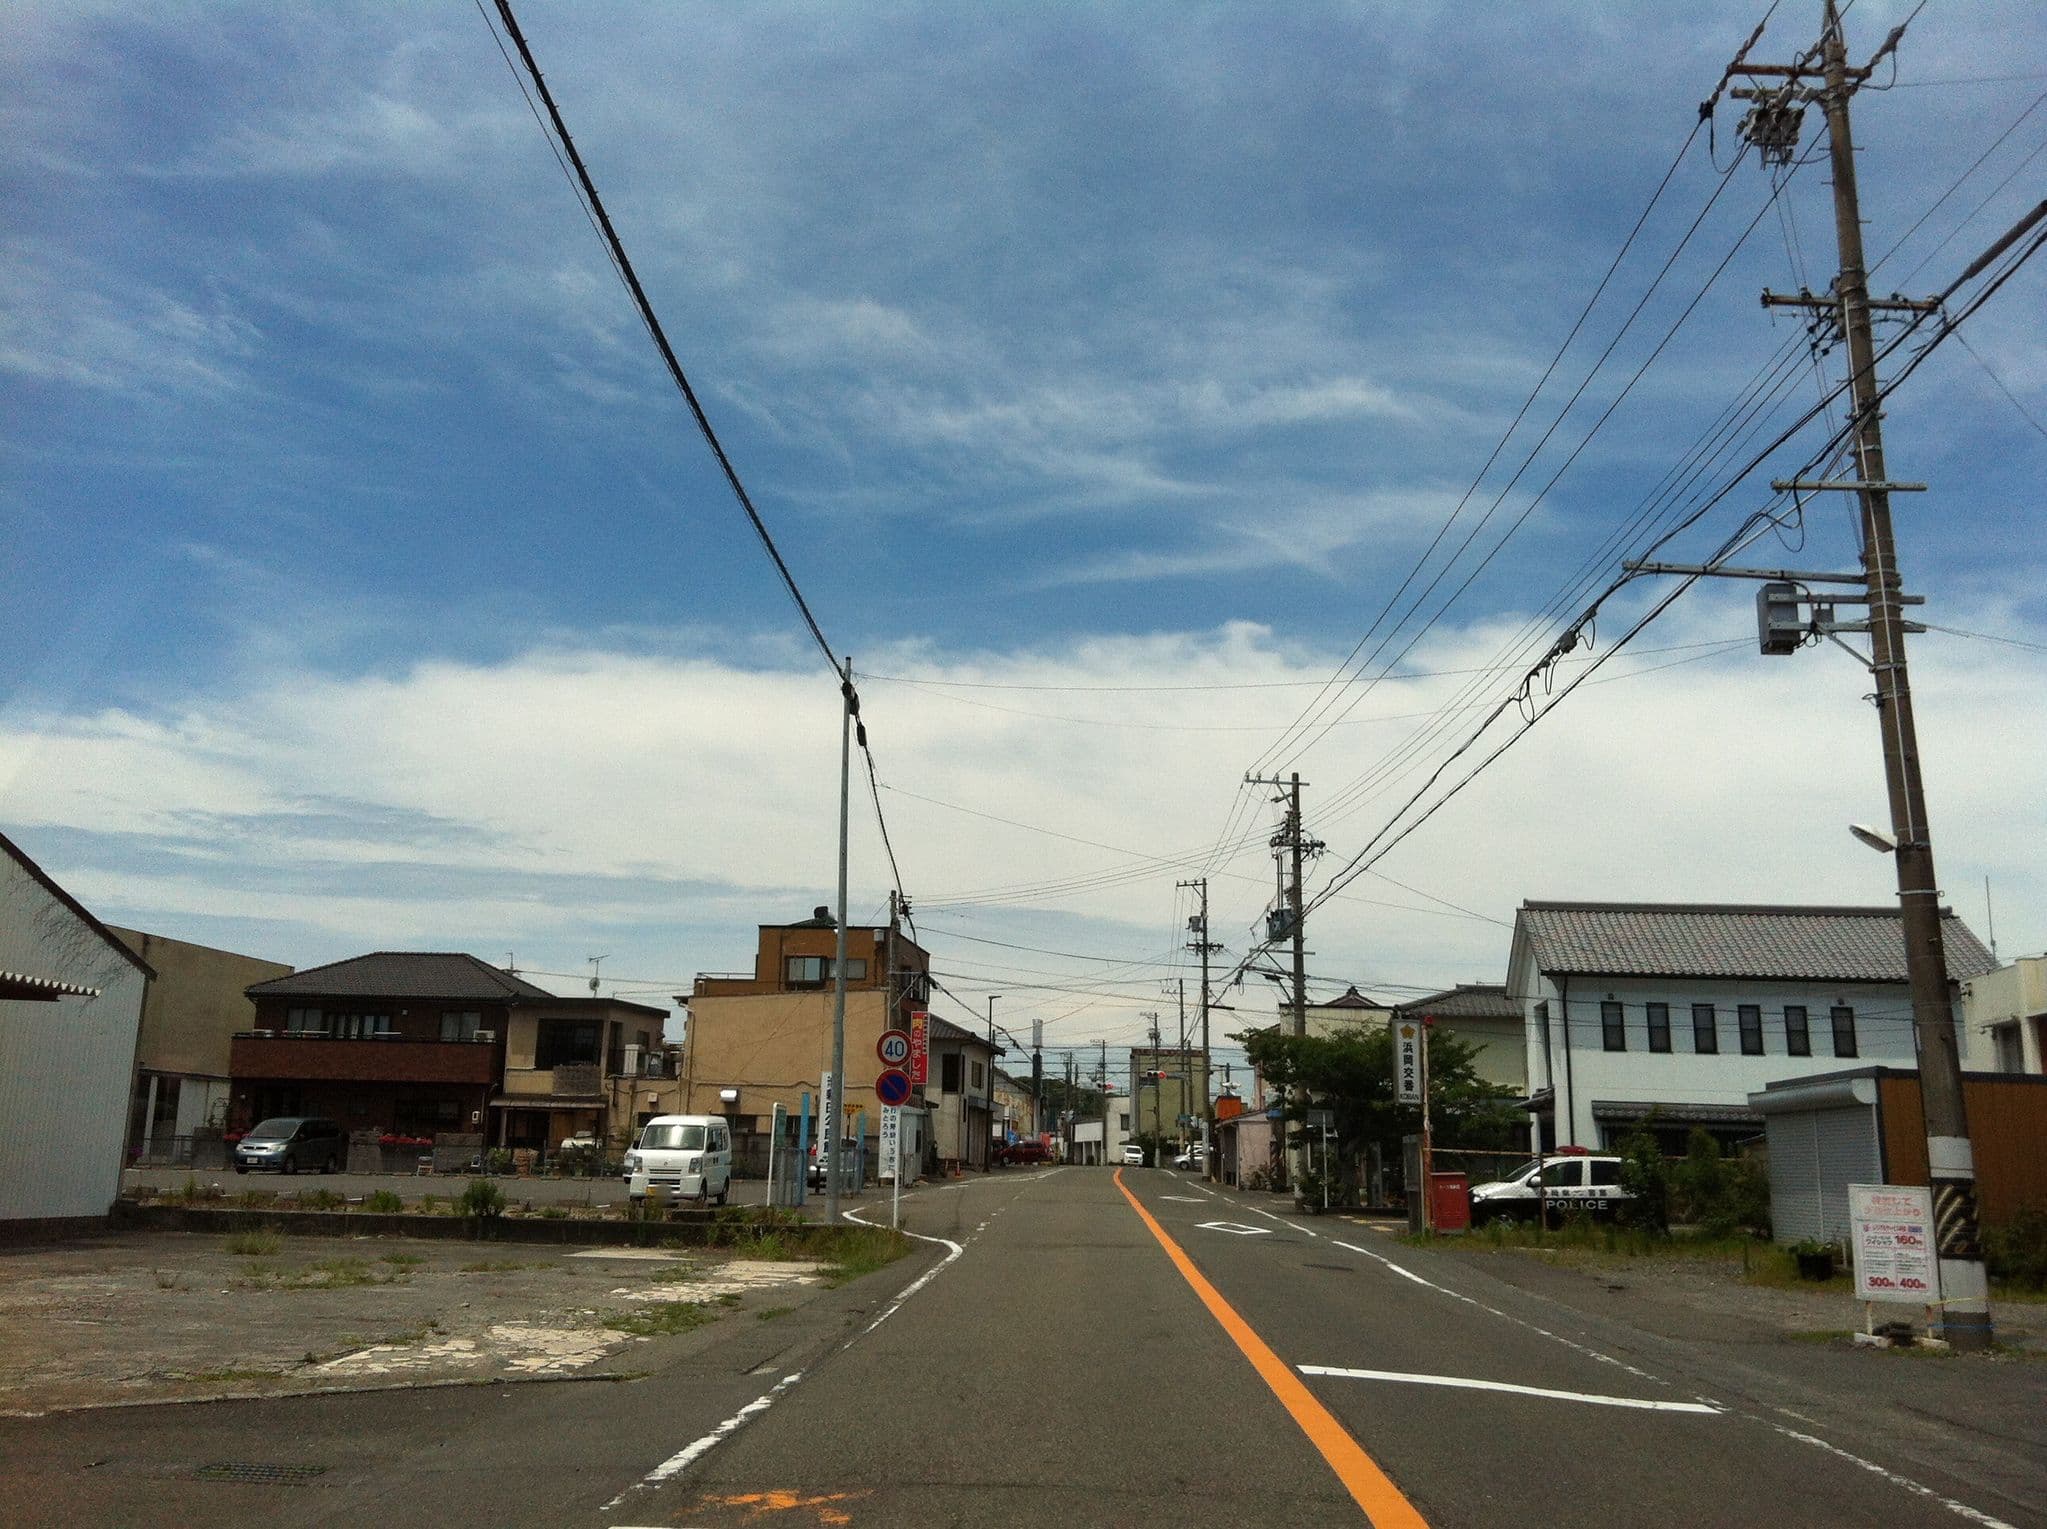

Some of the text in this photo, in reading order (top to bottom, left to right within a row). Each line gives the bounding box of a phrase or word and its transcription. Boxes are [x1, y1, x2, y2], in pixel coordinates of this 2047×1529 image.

[885, 1040, 905, 1057] 40
[1403, 1041, 1415, 1092] 浜岡交番
[1546, 1200, 1608, 1210] POLICE
